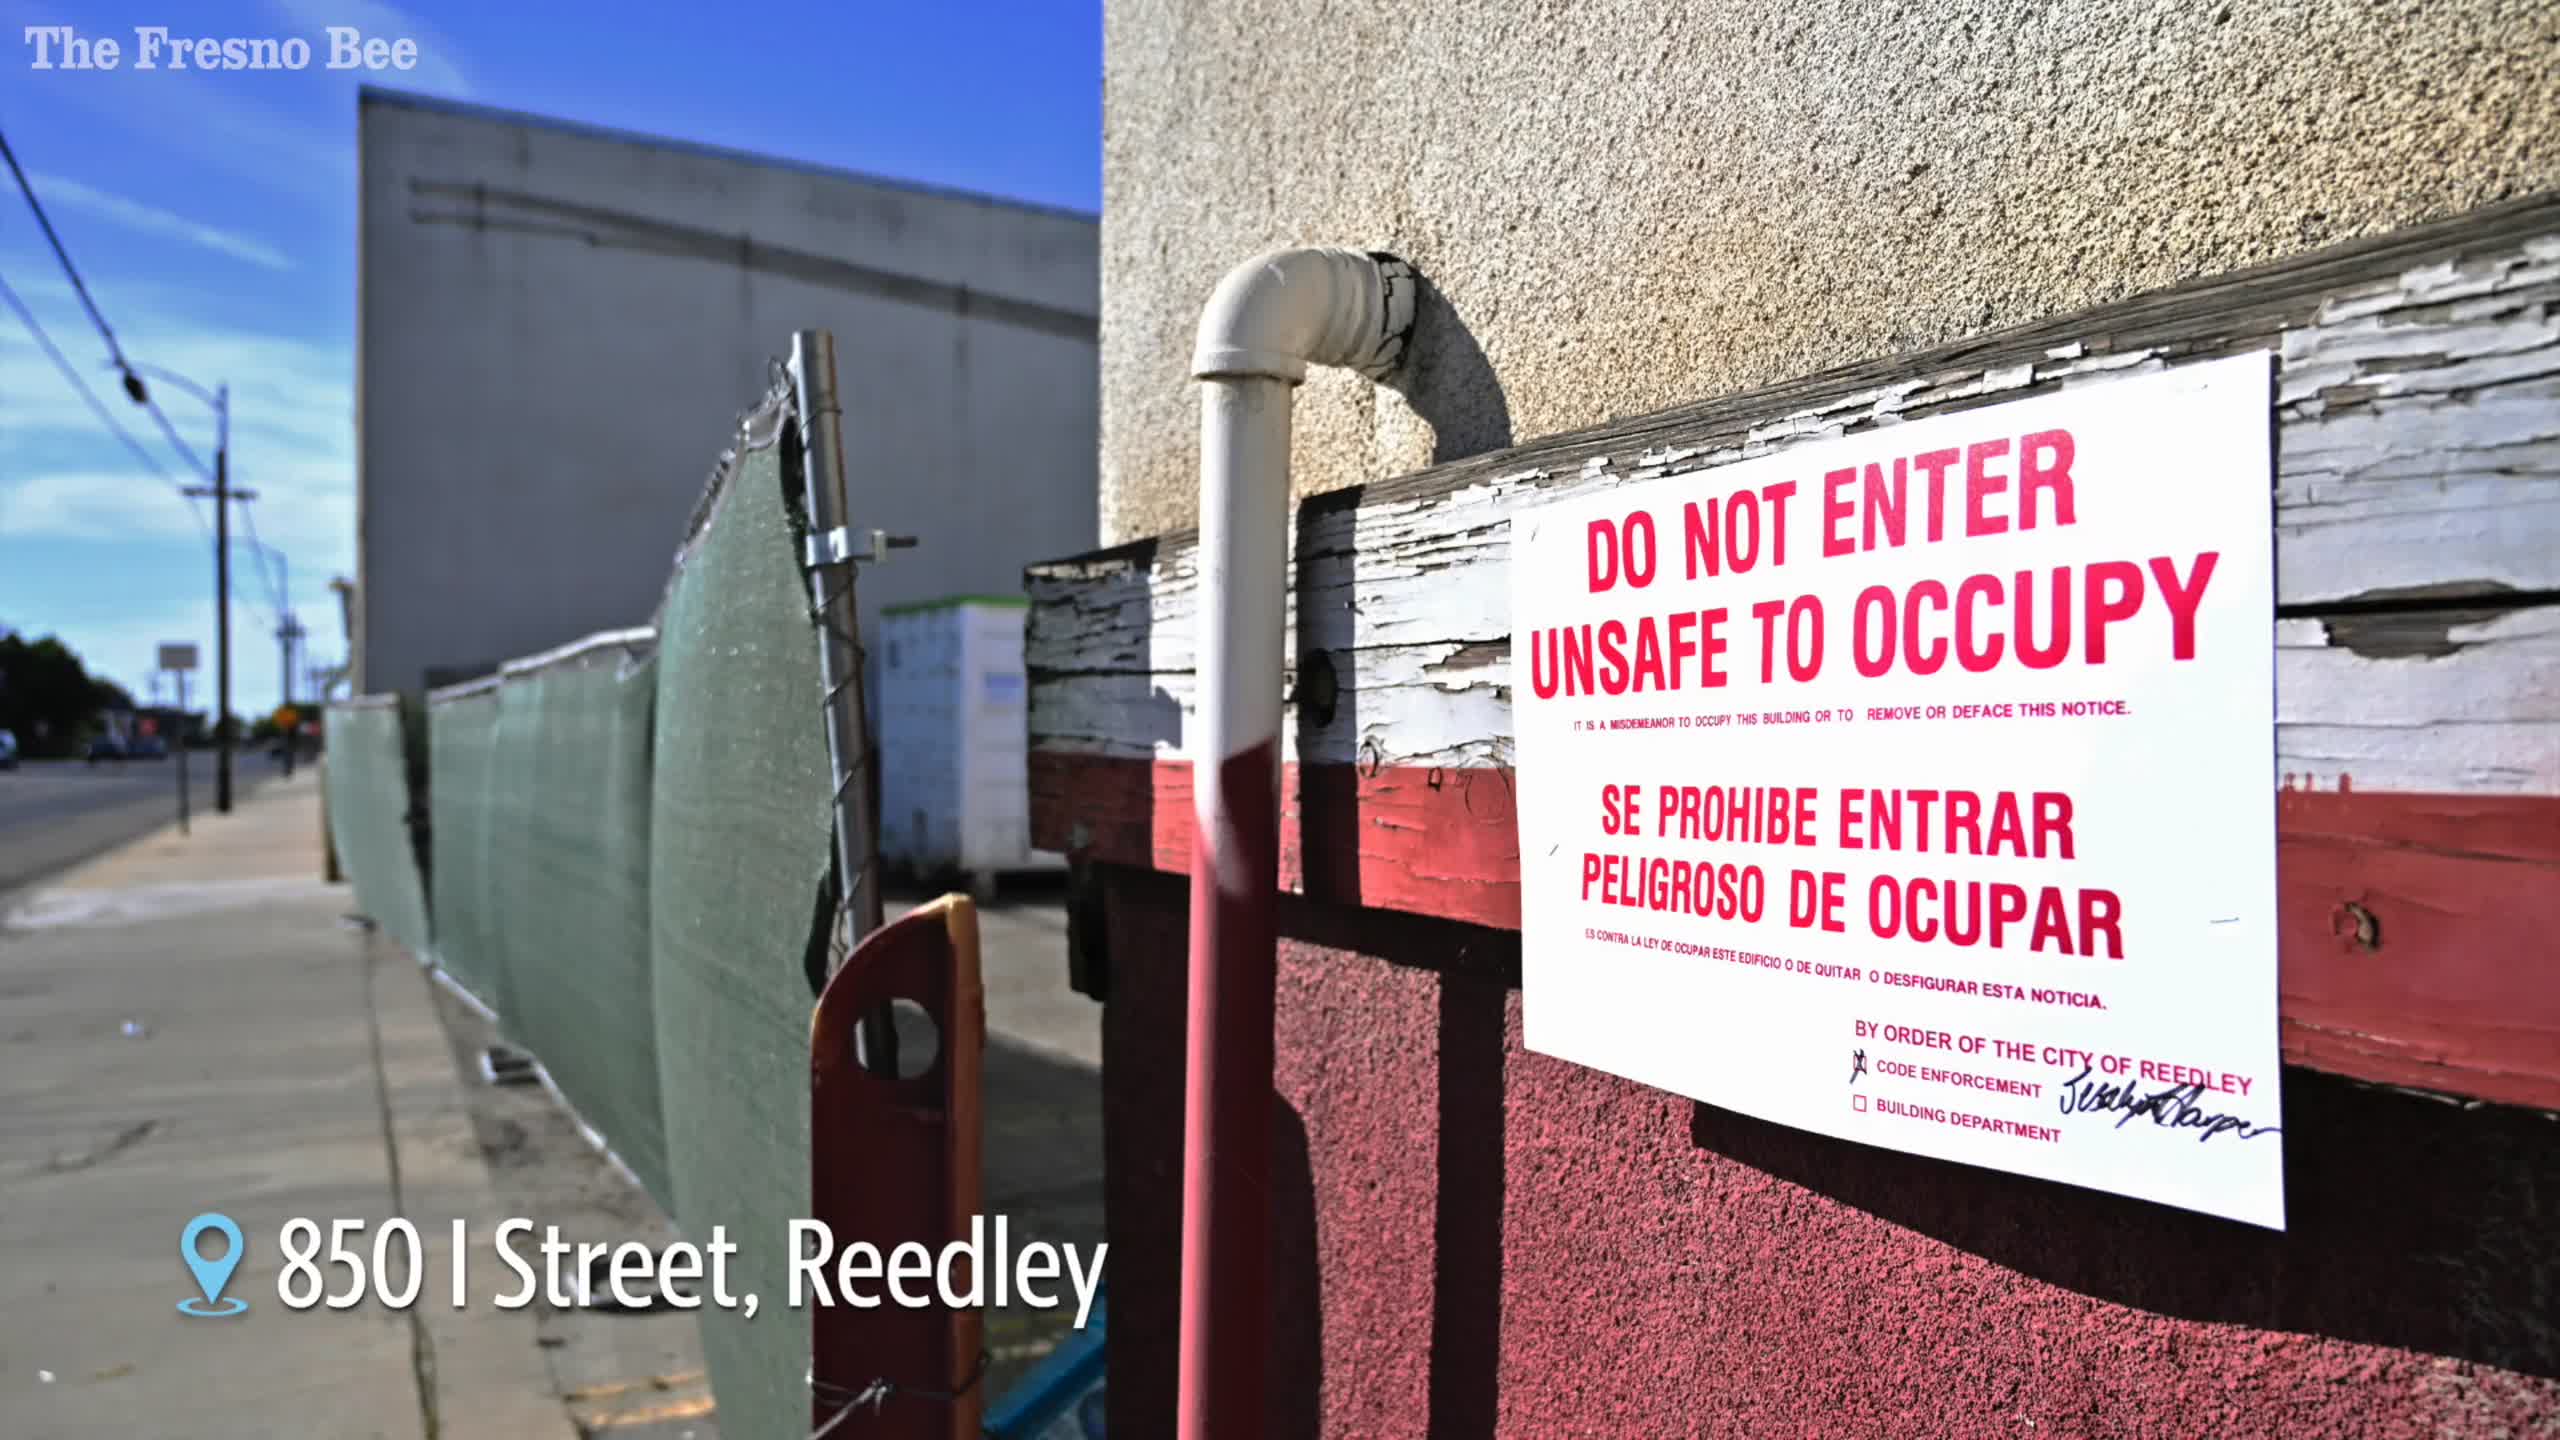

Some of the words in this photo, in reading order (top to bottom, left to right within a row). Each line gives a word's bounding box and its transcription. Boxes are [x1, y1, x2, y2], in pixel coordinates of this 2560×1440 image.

[1587, 511, 1657, 594] DO
[1684, 480, 1797, 581] NOT
[1823, 429, 2077, 558] ENTER
[1531, 608, 1728, 700] UNSAFE
[1752, 594, 1824, 684] TO
[1853, 551, 2220, 678] OCCUPY
[1574, 720, 1582, 731] IT
[1586, 720, 1595, 731] IS
[1599, 720, 1606, 730] A
[1610, 717, 1675, 730] MISDEMEANOR
[1679, 716, 1691, 728] TO
[1695, 714, 1731, 727] OCCUPY
[1736, 713, 1757, 725] THIS
[1763, 710, 1810, 724] BUILDING
[1815, 710, 1831, 722] OR
[1837, 709, 1853, 722] TO
[1867, 706, 1921, 720] REMOVE
[1926, 706, 1946, 720] OR
[1952, 704, 2013, 719] DEFACE
[2019, 702, 2056, 717] THIS
[2061, 700, 2132, 716] NOTICE.
[1601, 783, 1642, 837] SE
[1657, 784, 1819, 848] PROHIBE
[1839, 787, 2077, 861] ENTRAR
[1582, 852, 1766, 924] PELIGROSO
[1789, 869, 1847, 934] DE
[1868, 873, 2126, 961] OCUPAR
[1585, 928, 1595, 939] ES
[1596, 929, 1629, 945] CONTRA
[1631, 935, 1641, 946] LA
[1643, 938, 1659, 949] LEY
[1660, 940, 1672, 951] DE
[1674, 941, 1710, 958] OCUPAR
[1712, 948, 1736, 962] ESTE
[1738, 951, 1781, 969] EDIFICIO
[1784, 958, 1793, 971] O
[1796, 959, 1811, 974] DE
[1815, 963, 1861, 980] QUITAR
[1869, 969, 1879, 983] O
[1884, 971, 1978, 995] DESFIGURAR
[1982, 983, 2025, 1000] ESTA
[2031, 988, 2107, 1010] NOTICIA.
[1855, 1019, 1879, 1039] BY
[1884, 1024, 1952, 1050] ORDER
[1958, 1035, 1986, 1054] OF
[1992, 1040, 2036, 1062] THE
[2042, 1047, 2093, 1068] CITY
[2100, 1055, 2132, 1075] OF
[2140, 1059, 2252, 1096] REEDLEY
[1876, 1059, 1917, 1079] CODE
[1921, 1067, 2042, 1098] ENFORCEMENT
[1876, 1098, 1946, 1123] BUILDING
[1950, 1111, 2062, 1143] DEPARTMENT
